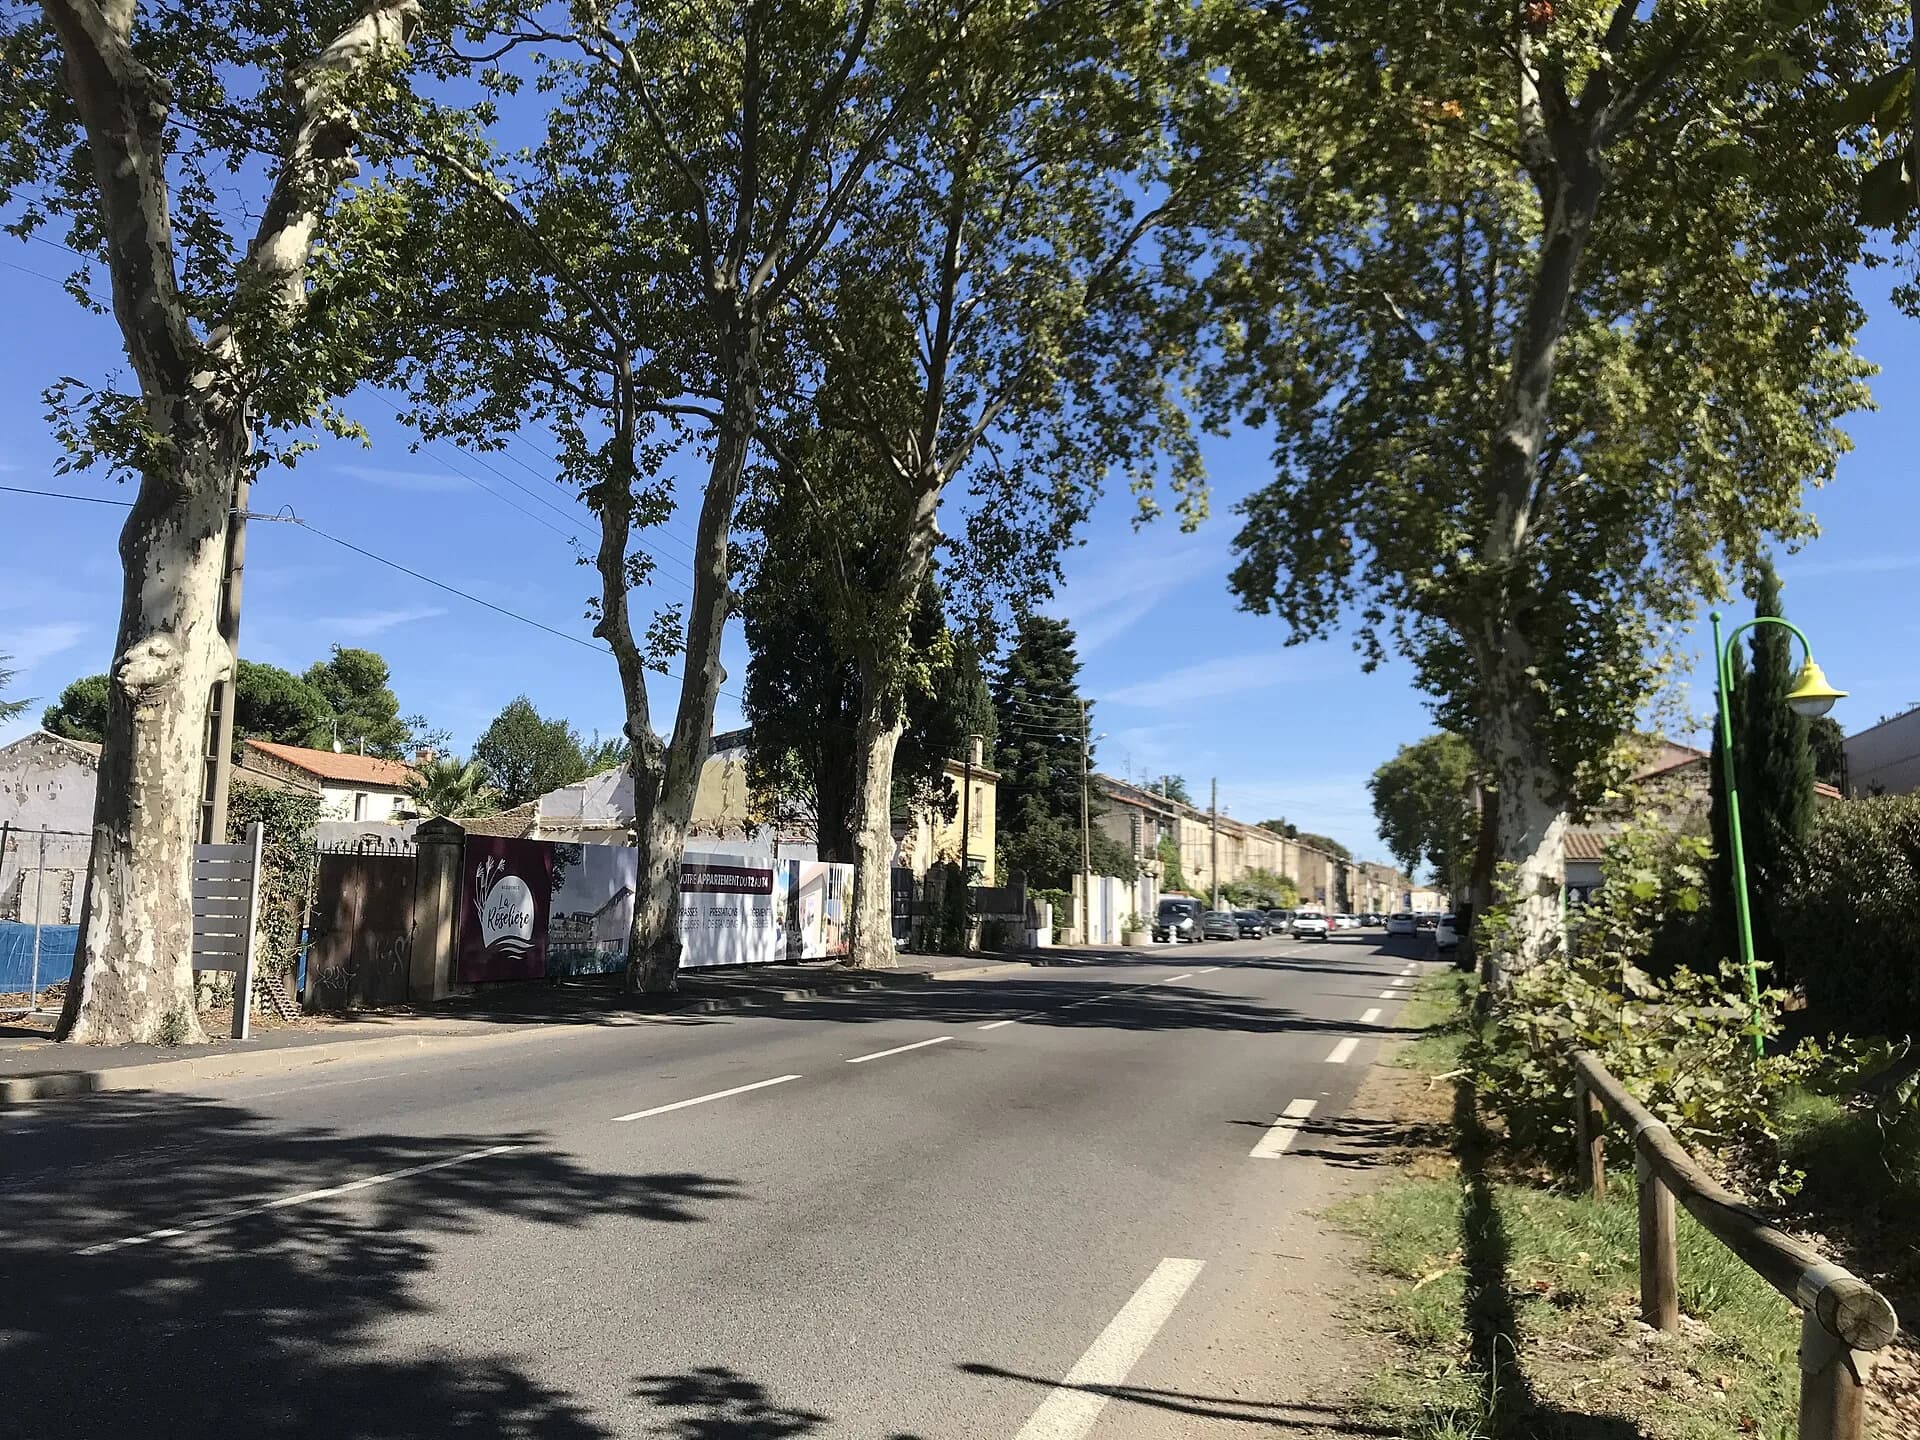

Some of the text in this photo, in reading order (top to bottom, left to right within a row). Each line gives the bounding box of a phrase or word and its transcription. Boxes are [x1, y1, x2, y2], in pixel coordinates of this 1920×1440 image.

[697, 873, 740, 887] APPARTEMENT
[740, 877, 748, 887] DU
[748, 876, 755, 887] T2
[755, 877, 761, 888] AU
[761, 877, 769, 888] T4
[499, 894, 509, 910] La
[680, 907, 698, 917] RASSES
[710, 907, 738, 917] PRESTATIONS
